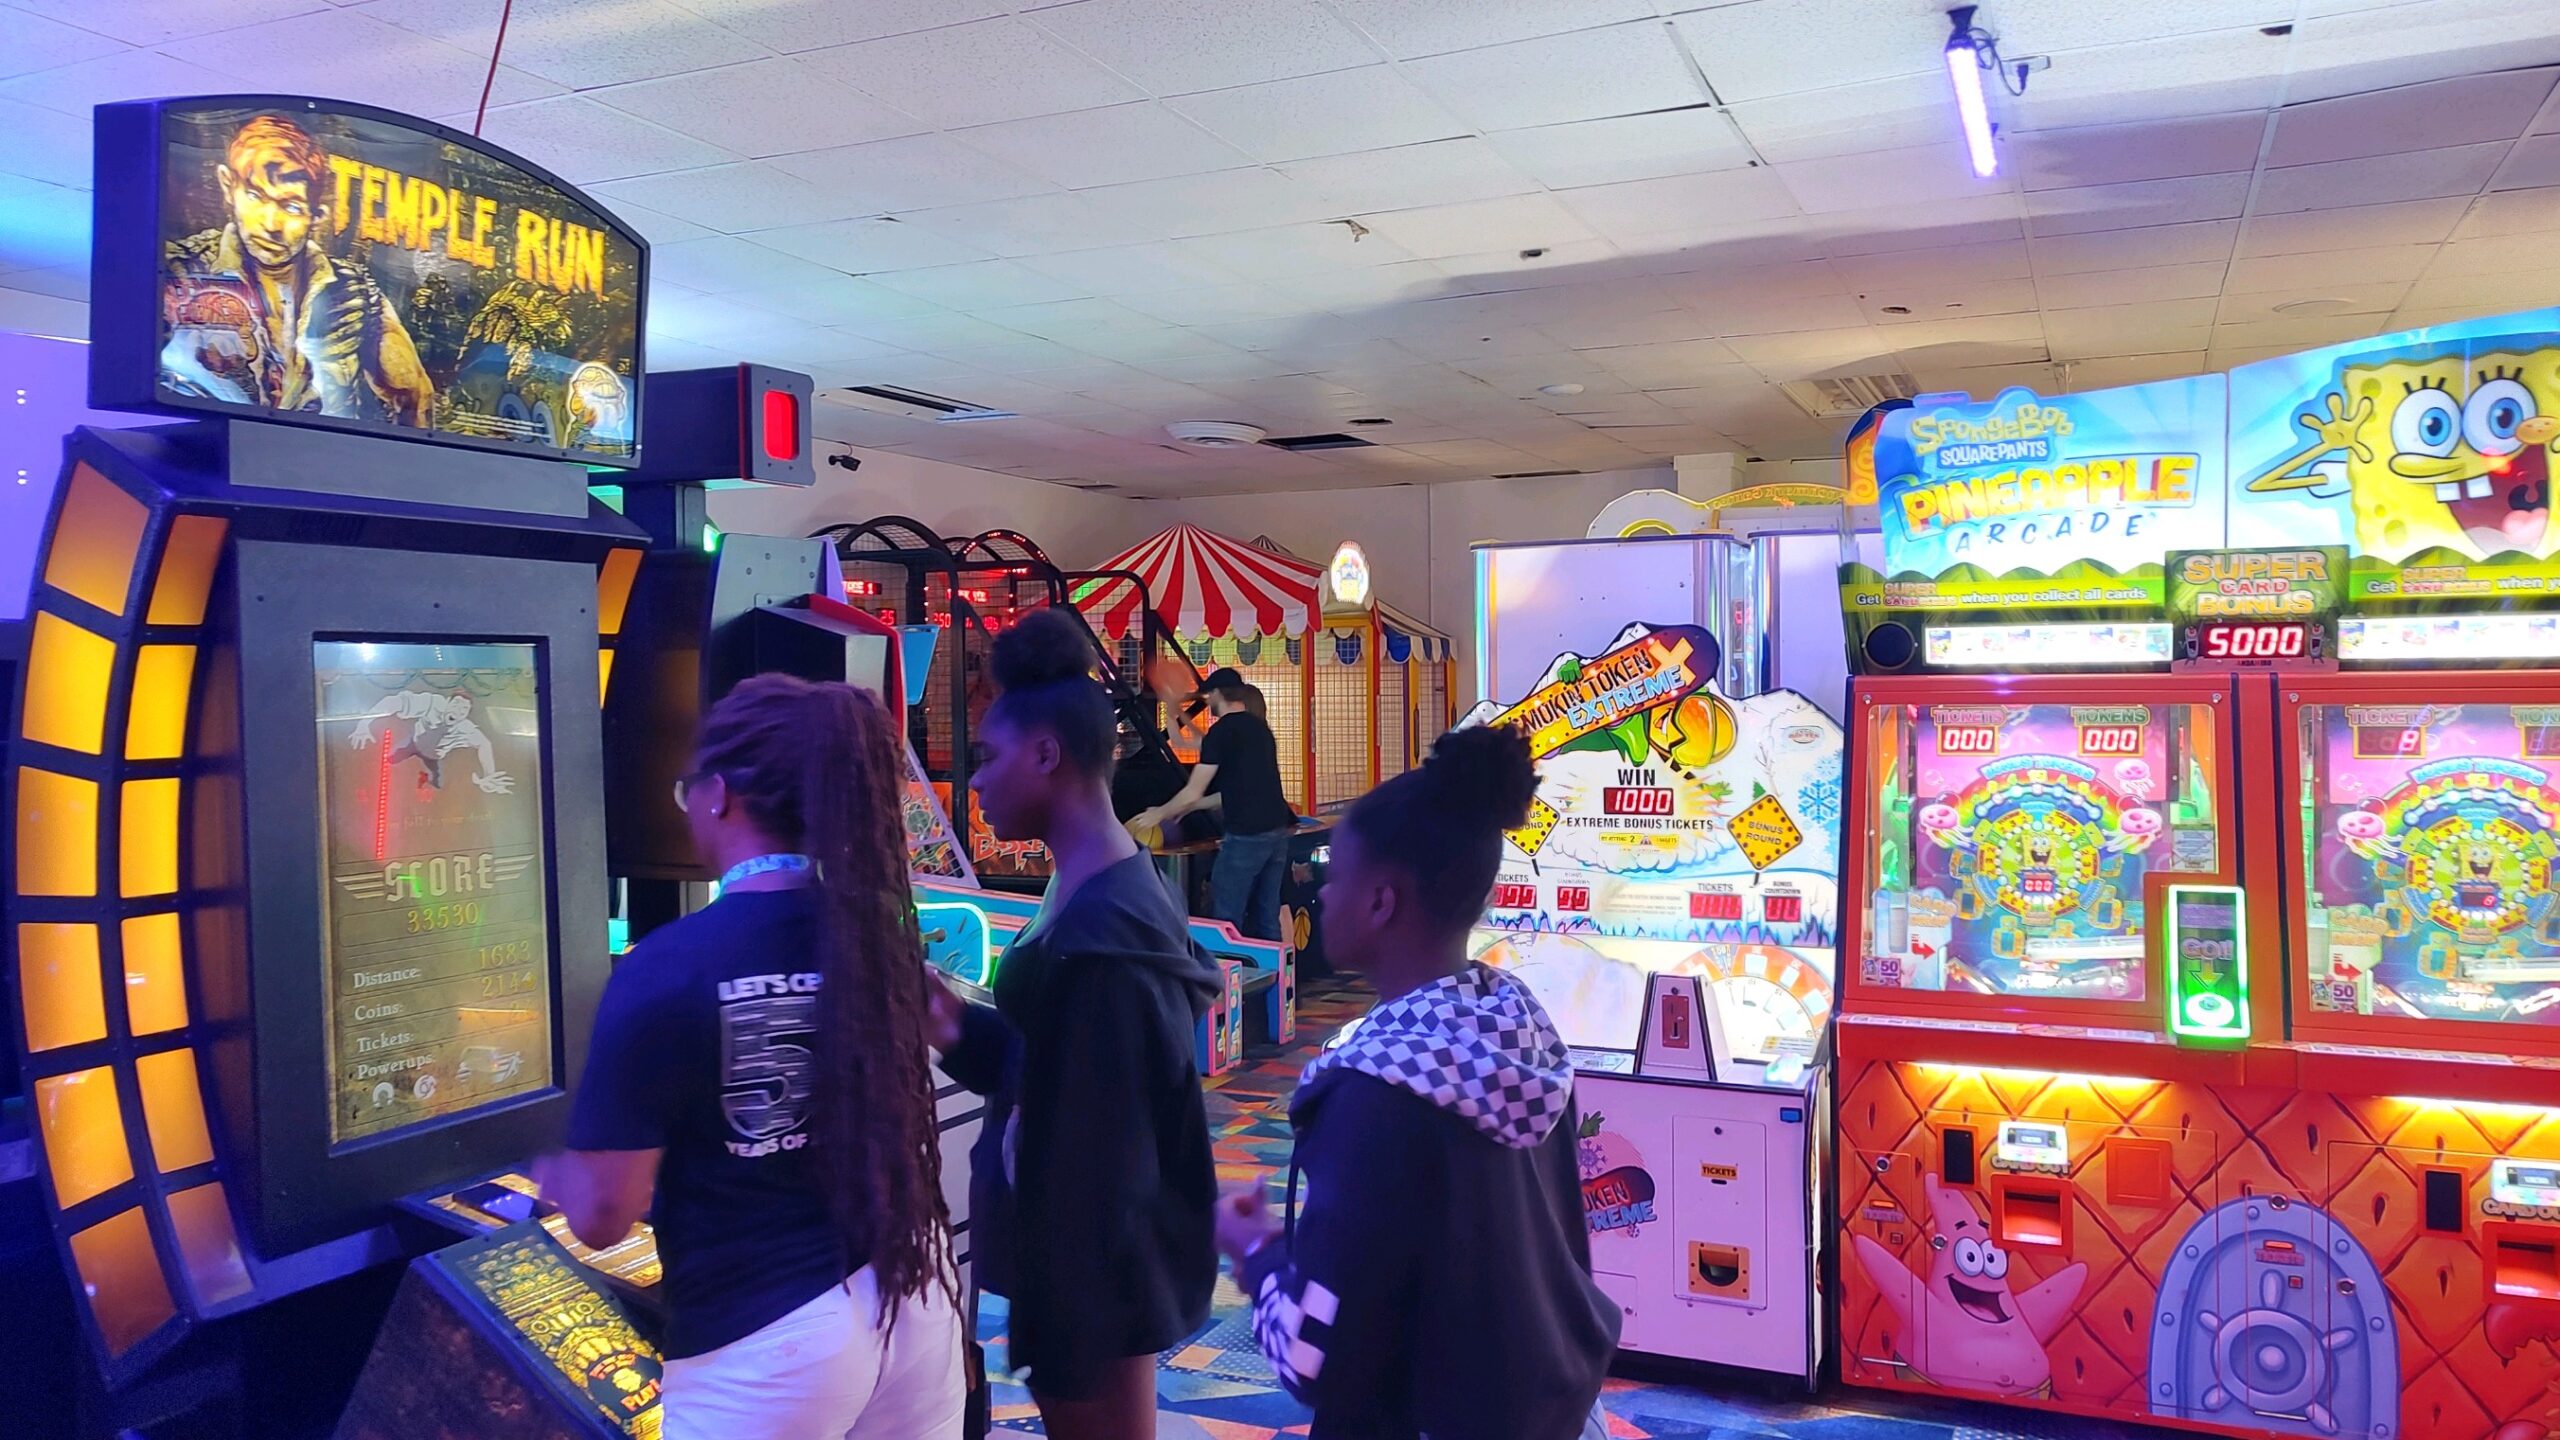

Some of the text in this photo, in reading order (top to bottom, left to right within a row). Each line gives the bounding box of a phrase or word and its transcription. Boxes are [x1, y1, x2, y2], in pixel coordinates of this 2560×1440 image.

[328, 153, 605, 301] TEMPLE RUN
[1940, 440, 2048, 466] SQUAREPANTS
[1901, 456, 2196, 533] PINEAPPLE
[1955, 512, 2144, 553] ARCADE
[2183, 550, 2328, 582] SUPER
[2219, 579, 2290, 595] CARD
[2367, 581, 2397, 593] Get
[2497, 576, 2544, 589] when
[1856, 593, 1880, 606] Get
[1961, 590, 2000, 604] when
[2003, 591, 2028, 606] you
[2033, 588, 2080, 602] collect
[2084, 587, 2101, 600] all
[2105, 586, 2148, 600] cards
[2197, 590, 2316, 616] BONUS
[2208, 626, 2304, 656] 5000
[1584, 649, 1653, 697] TOKEN
[1567, 664, 1686, 729] EXTREME
[2076, 709, 2147, 723] TOKENS
[2349, 708, 2433, 724] TICKETS
[1943, 729, 1994, 750] 000
[2084, 729, 2138, 751] 000
[1617, 769, 1656, 787] WIN
[1613, 789, 1672, 813] 1000
[1566, 817, 1713, 831] EXTREME BONUS TICKETS
[1748, 821, 1784, 835] BONUS
[1746, 832, 1782, 846] ROUND
[384, 853, 495, 902] SCORE
[1698, 883, 1734, 892] TICKETS
[1880, 961, 1898, 973] 50
[2333, 985, 2354, 997] 50
[356, 1031, 415, 1053] Tickets:
[781, 1133, 808, 1150] OF
[1702, 1166, 1737, 1178] TICKETS
